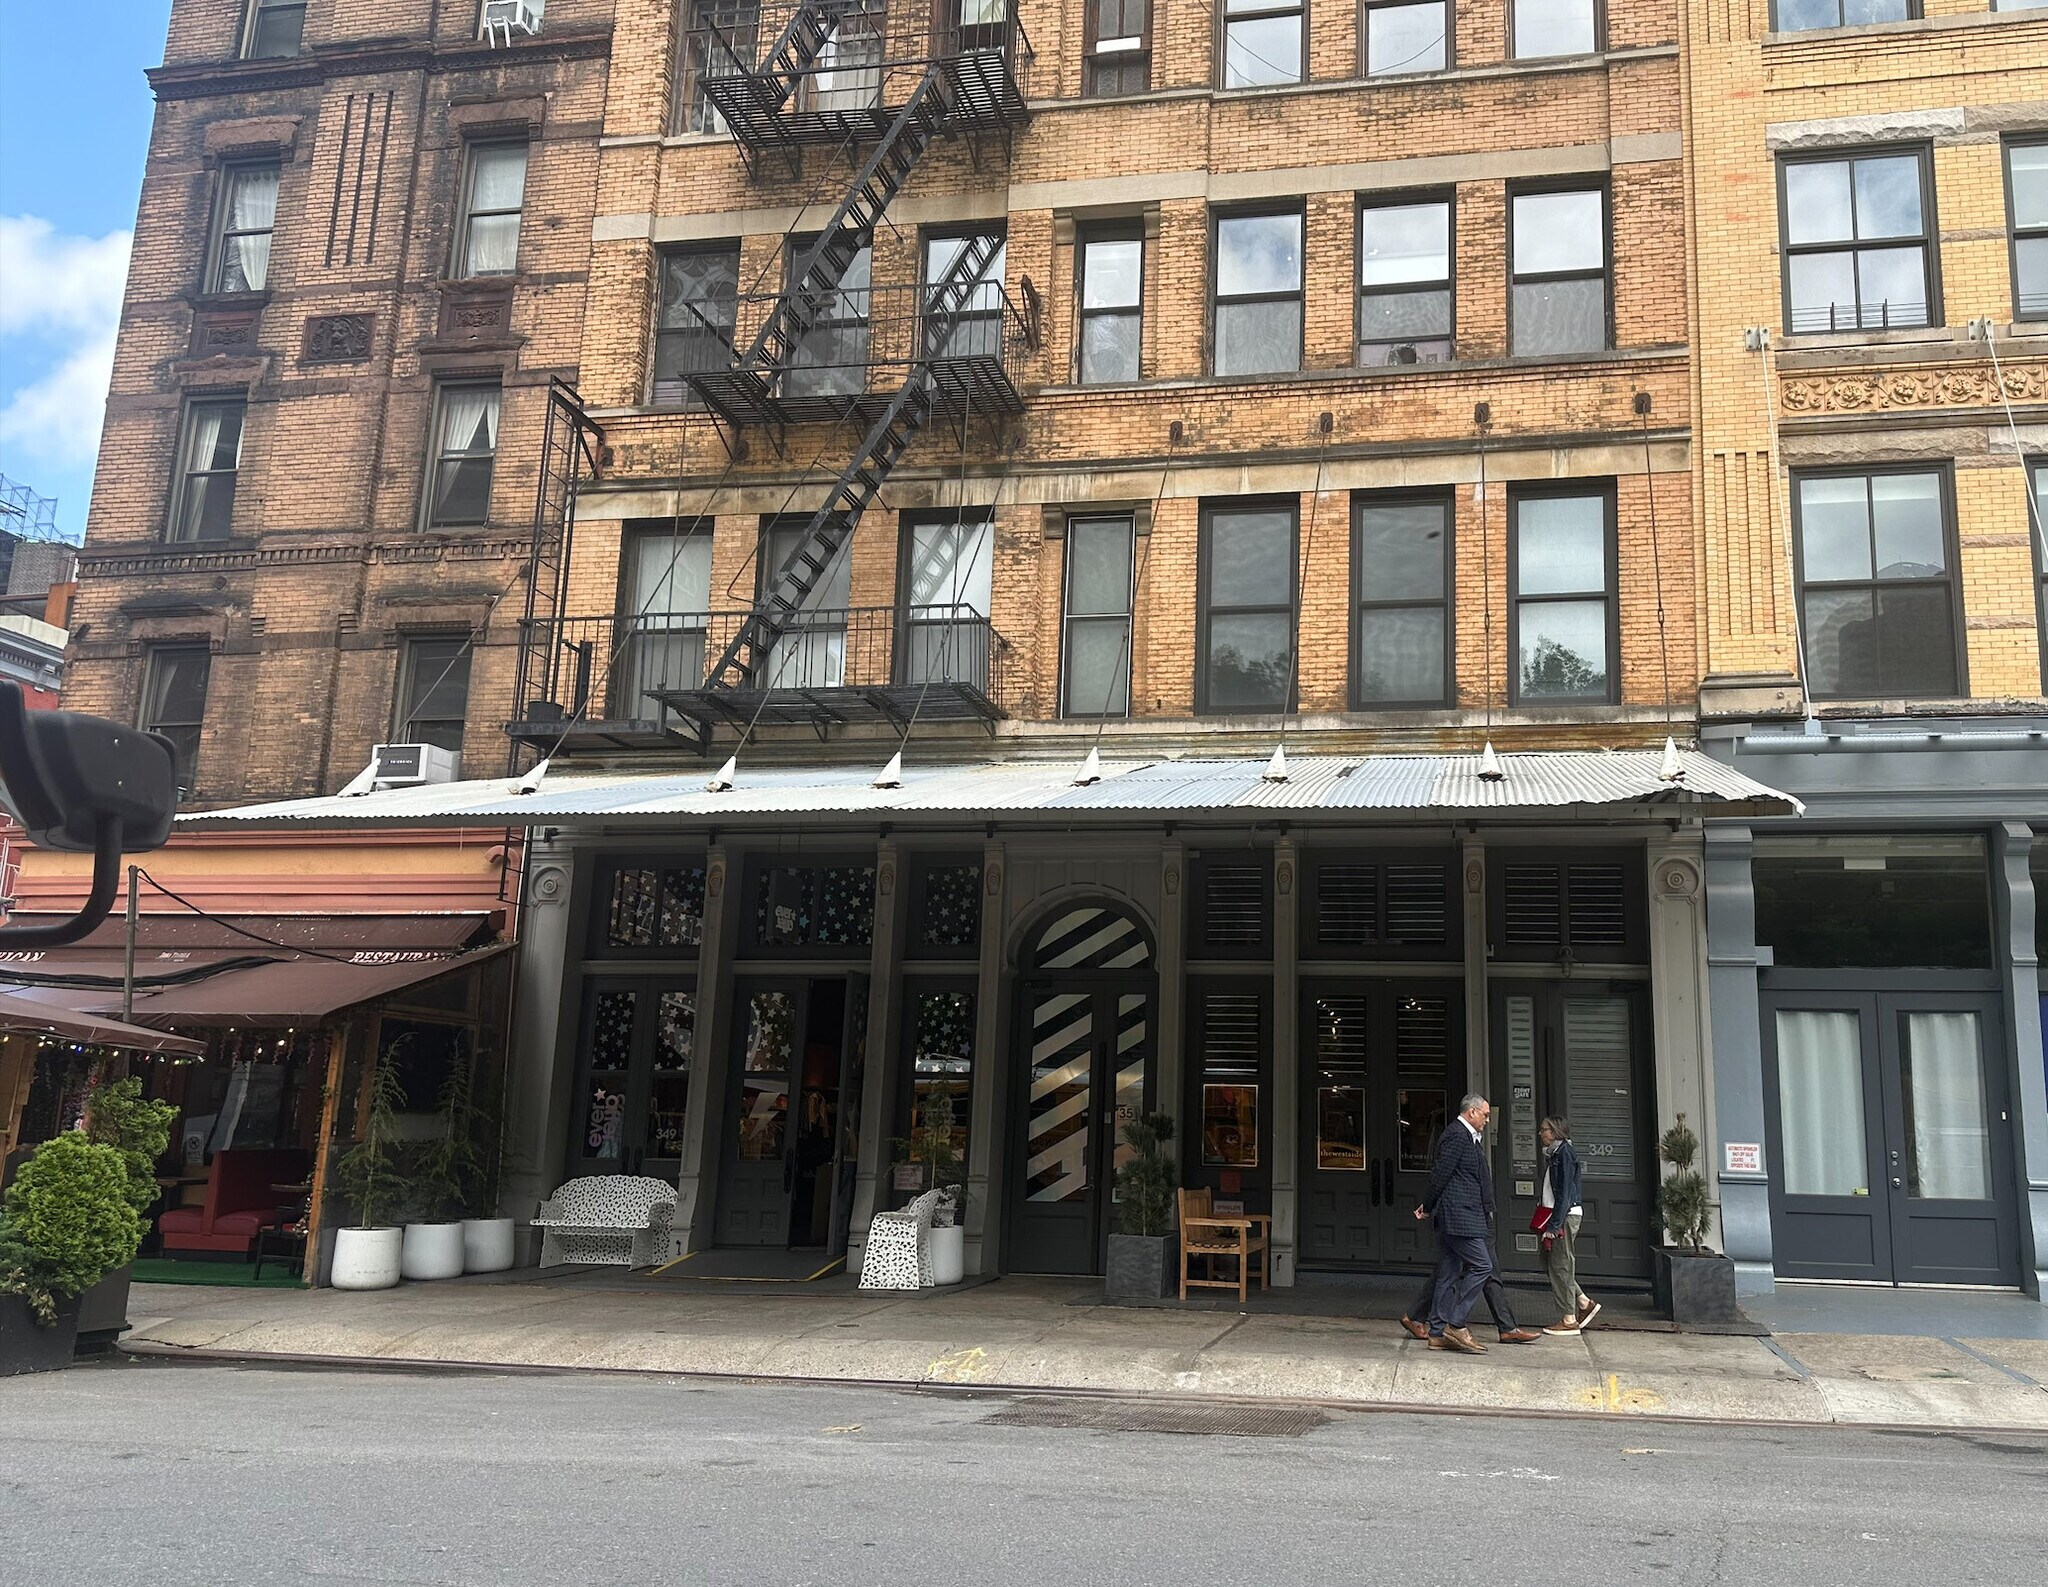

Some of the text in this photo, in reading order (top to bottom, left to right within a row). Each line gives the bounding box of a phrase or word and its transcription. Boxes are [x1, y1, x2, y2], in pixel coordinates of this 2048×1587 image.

[1119, 1107, 1139, 1119] 35
[588, 1102, 605, 1147] ever
[656, 1128, 677, 1139] 349
[1589, 1144, 1614, 1156] 349
